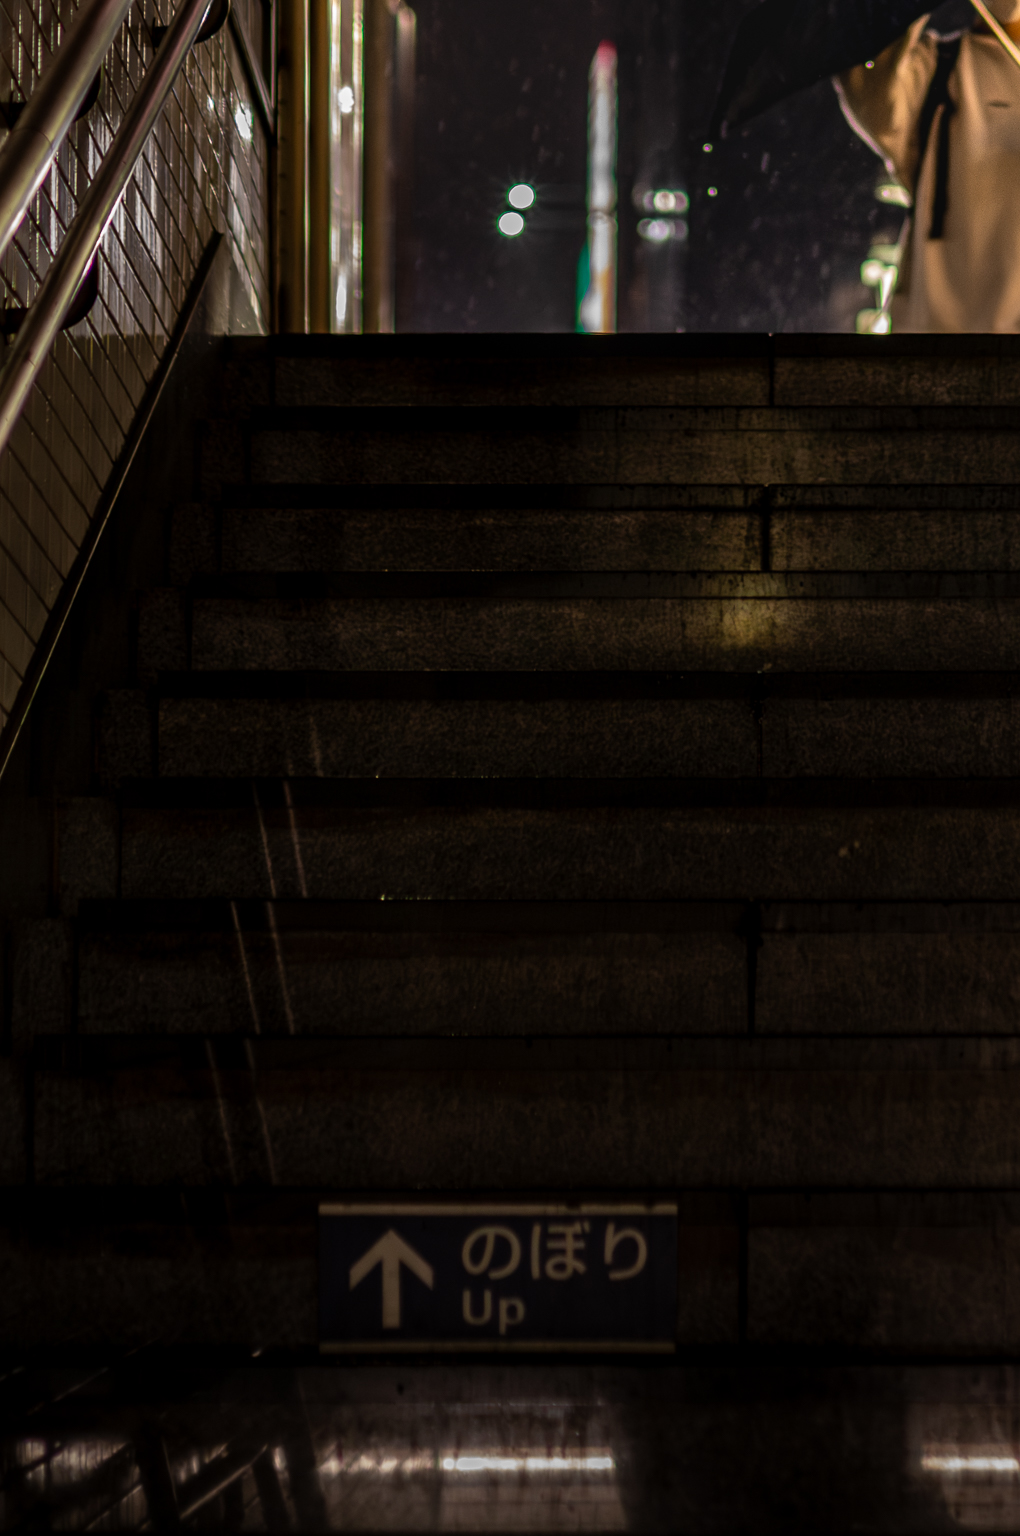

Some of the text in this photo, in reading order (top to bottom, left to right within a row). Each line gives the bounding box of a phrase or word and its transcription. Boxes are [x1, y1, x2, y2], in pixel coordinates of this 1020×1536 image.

[461, 1221, 647, 1281] のぼり
[461, 1287, 525, 1334] Up
